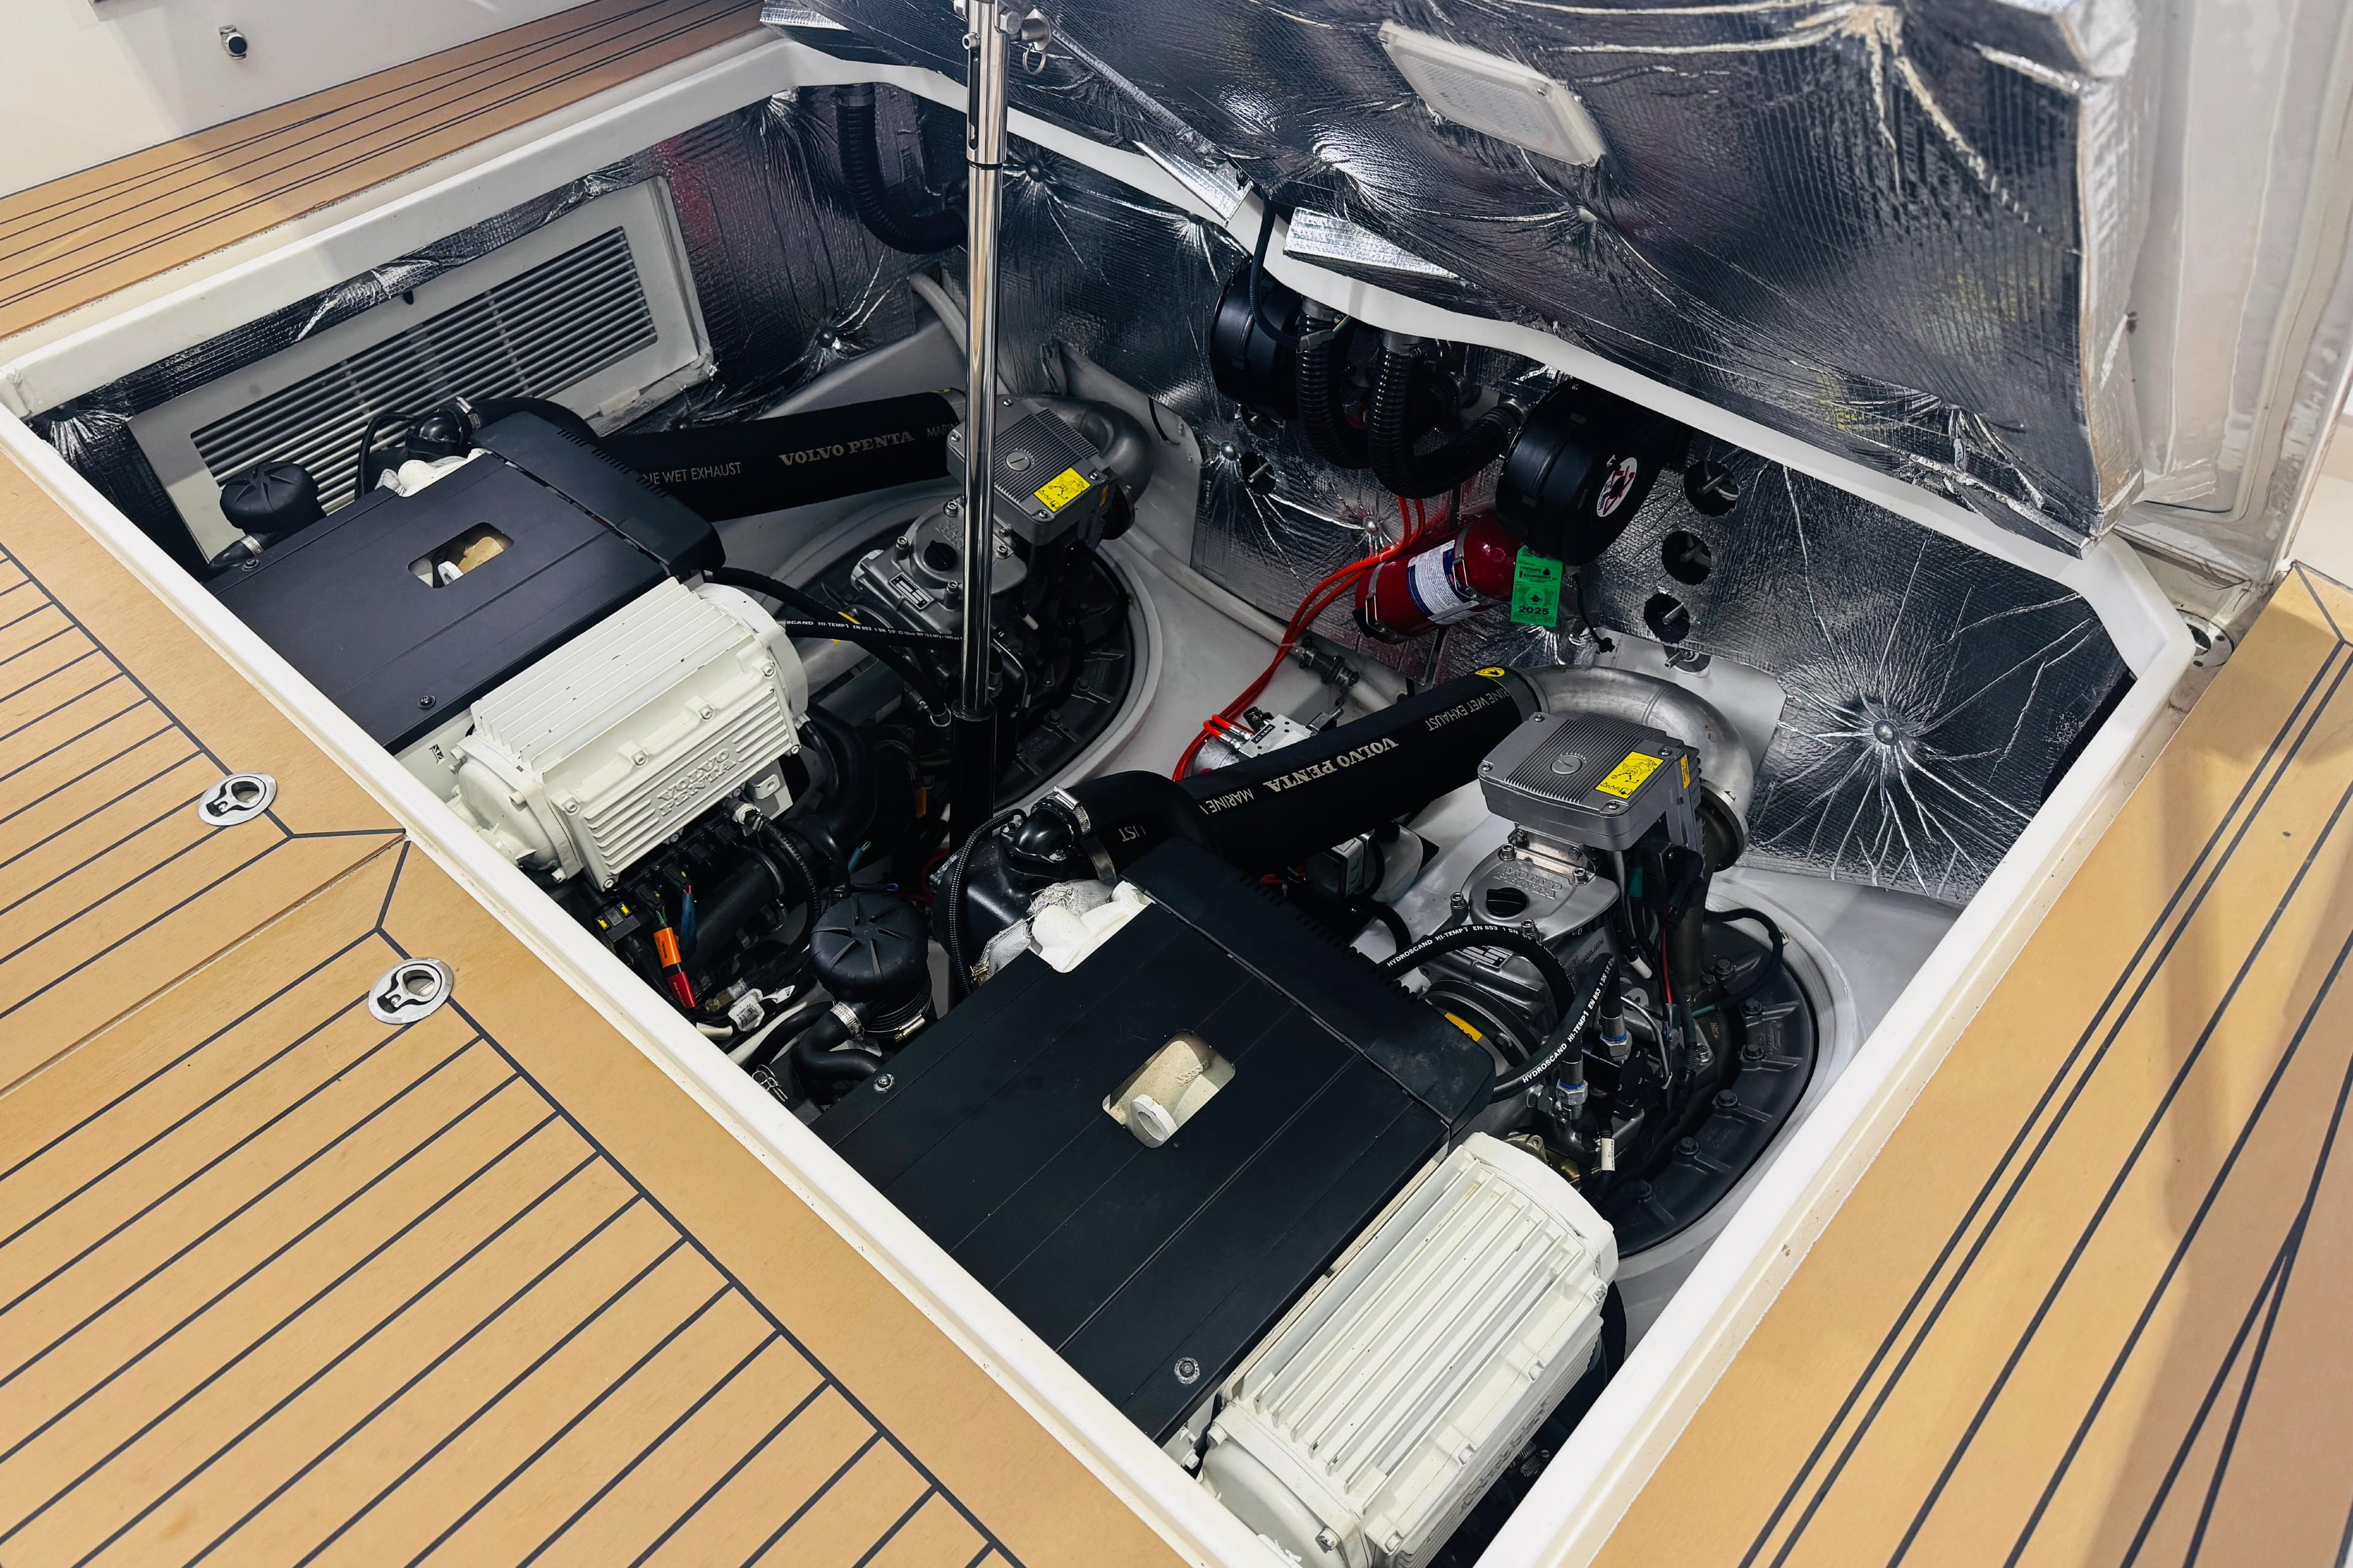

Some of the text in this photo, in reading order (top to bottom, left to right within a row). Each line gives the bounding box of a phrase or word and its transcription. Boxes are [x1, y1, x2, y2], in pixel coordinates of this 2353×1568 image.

[662, 469, 687, 483] WET
[691, 462, 741, 480] EXHAUST
[778, 444, 845, 466] VOLVO
[847, 431, 915, 454] PENTA
[1519, 606, 1549, 615] 2025
[1425, 705, 1469, 731] EXHAUST
[1466, 697, 1490, 713] WET
[657, 749, 730, 801] VOLVO
[659, 760, 736, 816] PENTA
[1205, 737, 1399, 814] VOLVO PENTA MARINE
[1387, 939, 1433, 967] HYDROSCAND
[1522, 1043, 1567, 1083] HYDROSCAND
[1588, 999, 1596, 1010] EN
[1593, 988, 1601, 1000] 853
